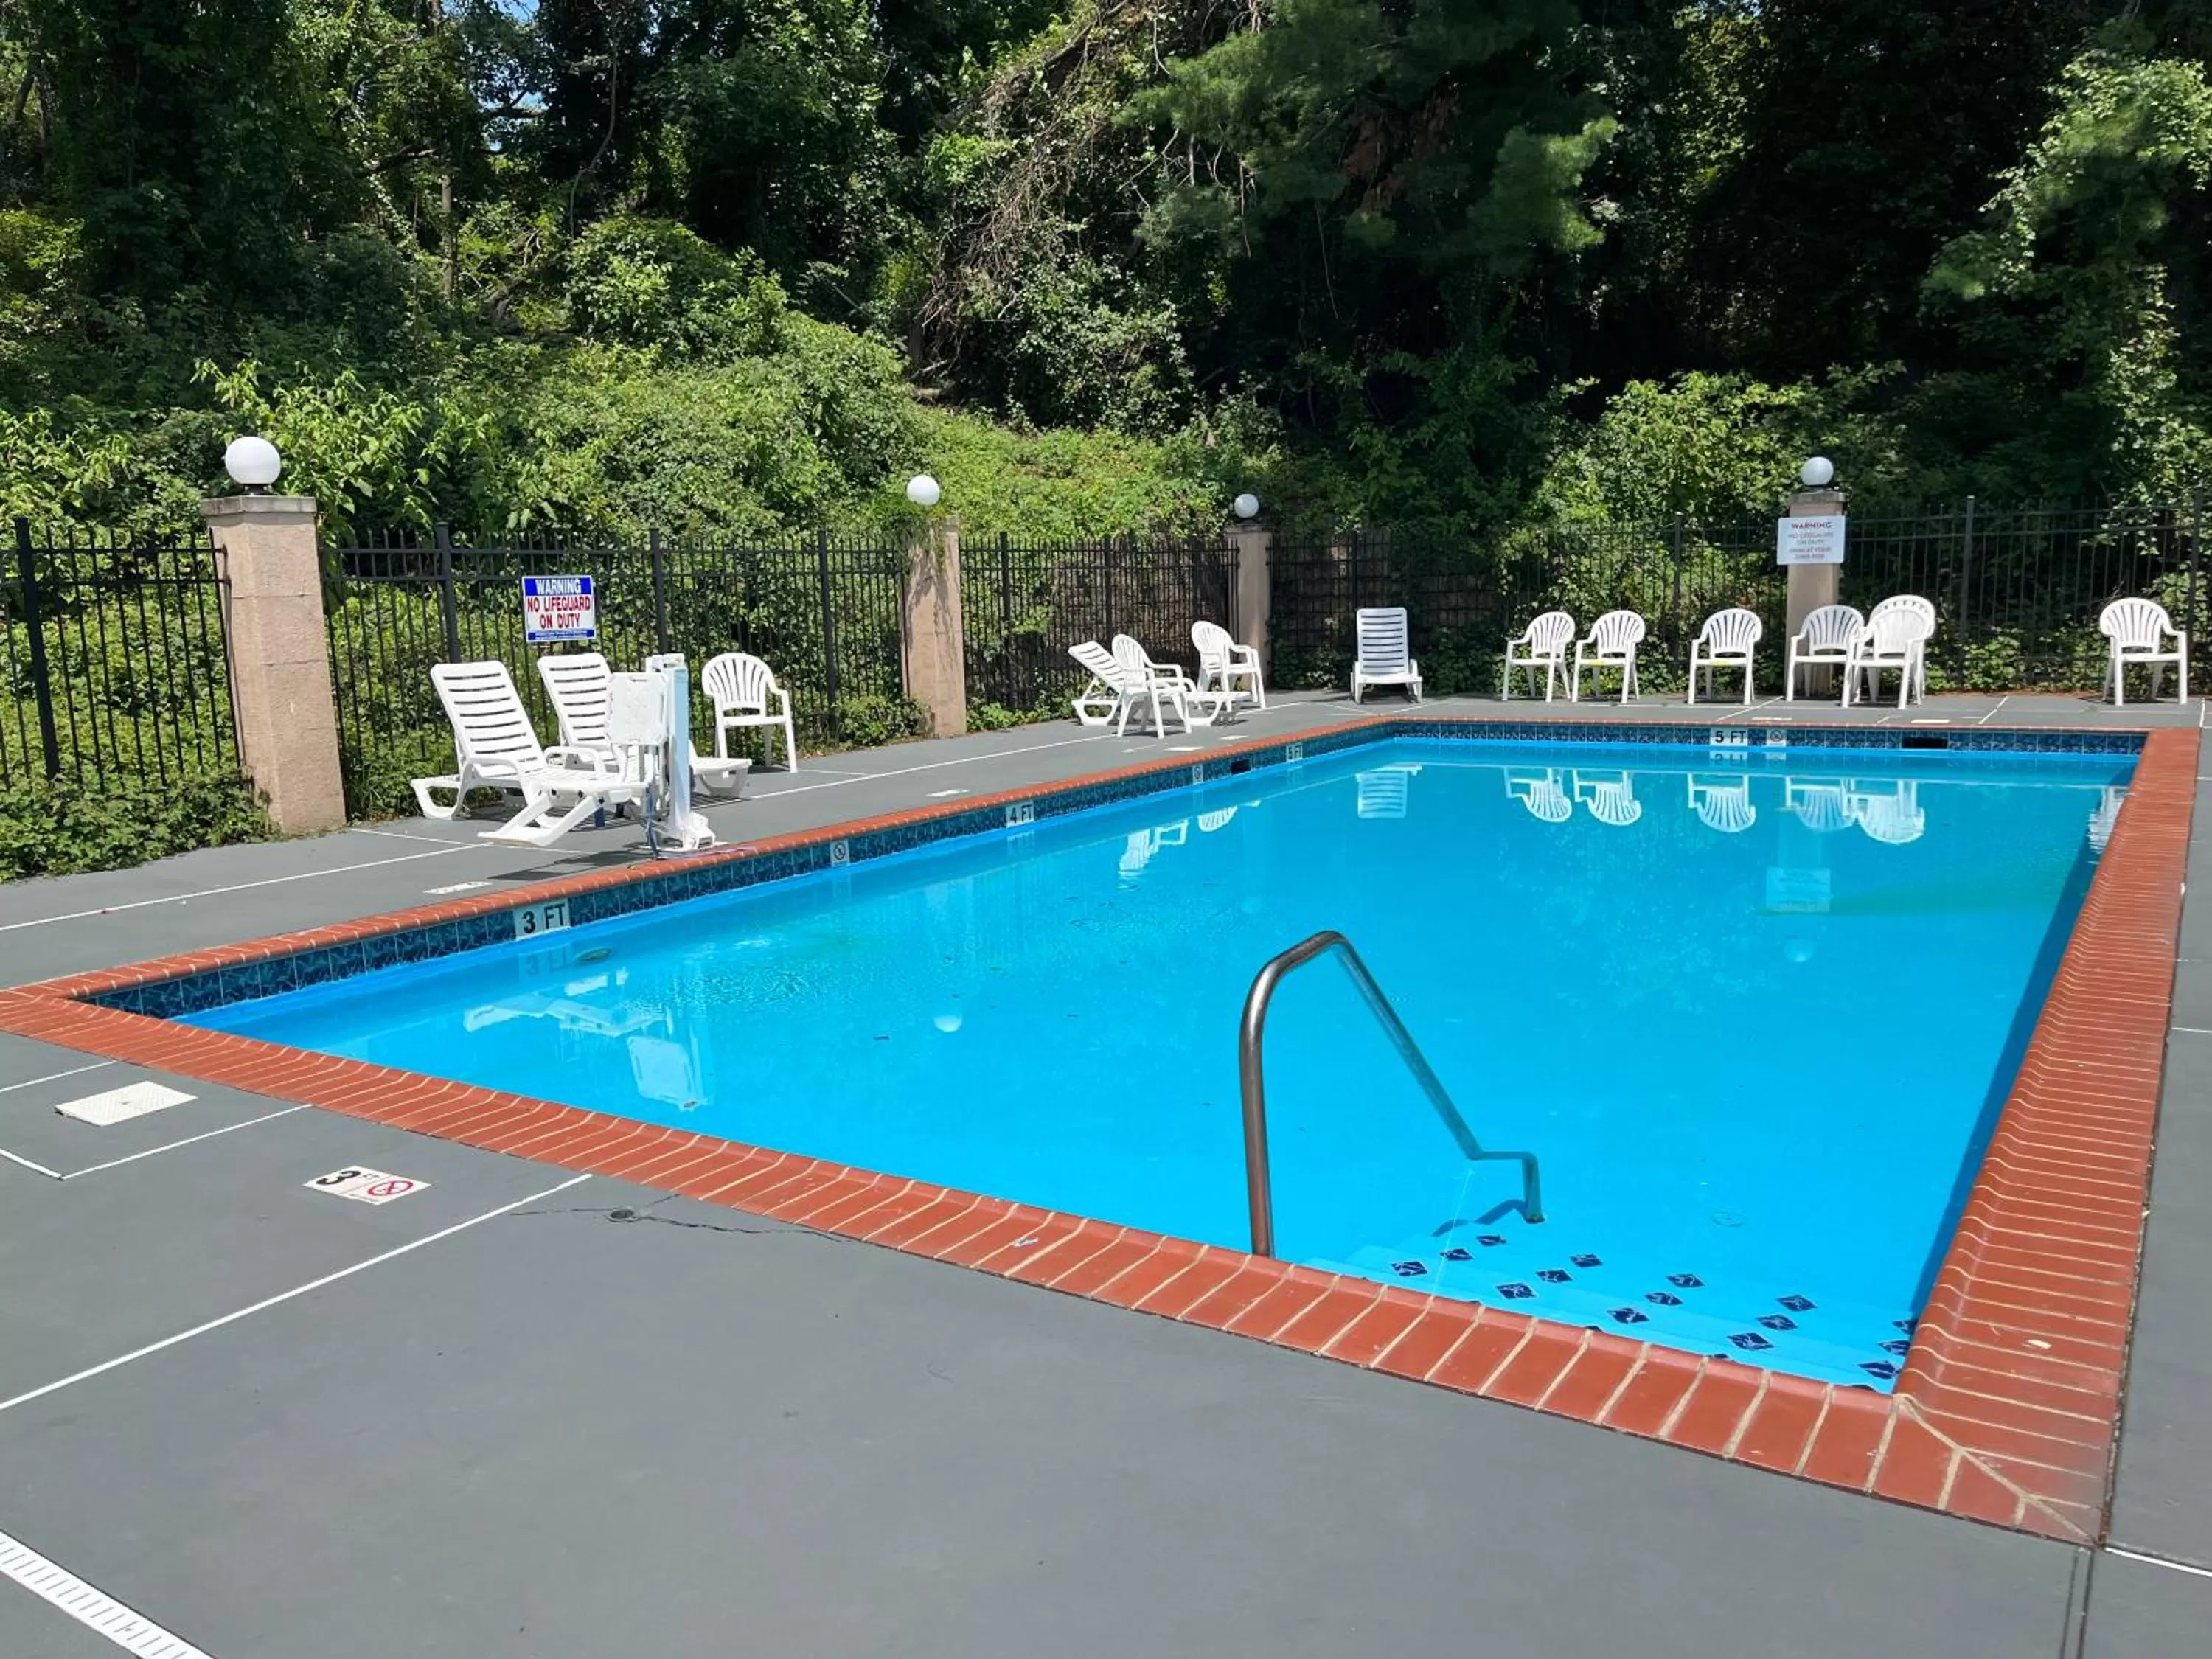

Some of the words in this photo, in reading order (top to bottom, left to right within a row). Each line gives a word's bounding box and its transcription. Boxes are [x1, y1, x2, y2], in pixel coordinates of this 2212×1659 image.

[535, 578, 582, 594] WARNING
[527, 597, 540, 612] NO
[544, 596, 590, 612] LIFEGUARD
[540, 614, 552, 629] ON
[557, 613, 580, 628] DUTY
[1715, 731, 1724, 743] 5
[1731, 731, 1746, 743] FT
[1010, 807, 1017, 823] 4
[1021, 804, 1032, 822] FT
[522, 911, 536, 933] 3
[544, 903, 565, 929] FT
[316, 1170, 361, 1185] 3
